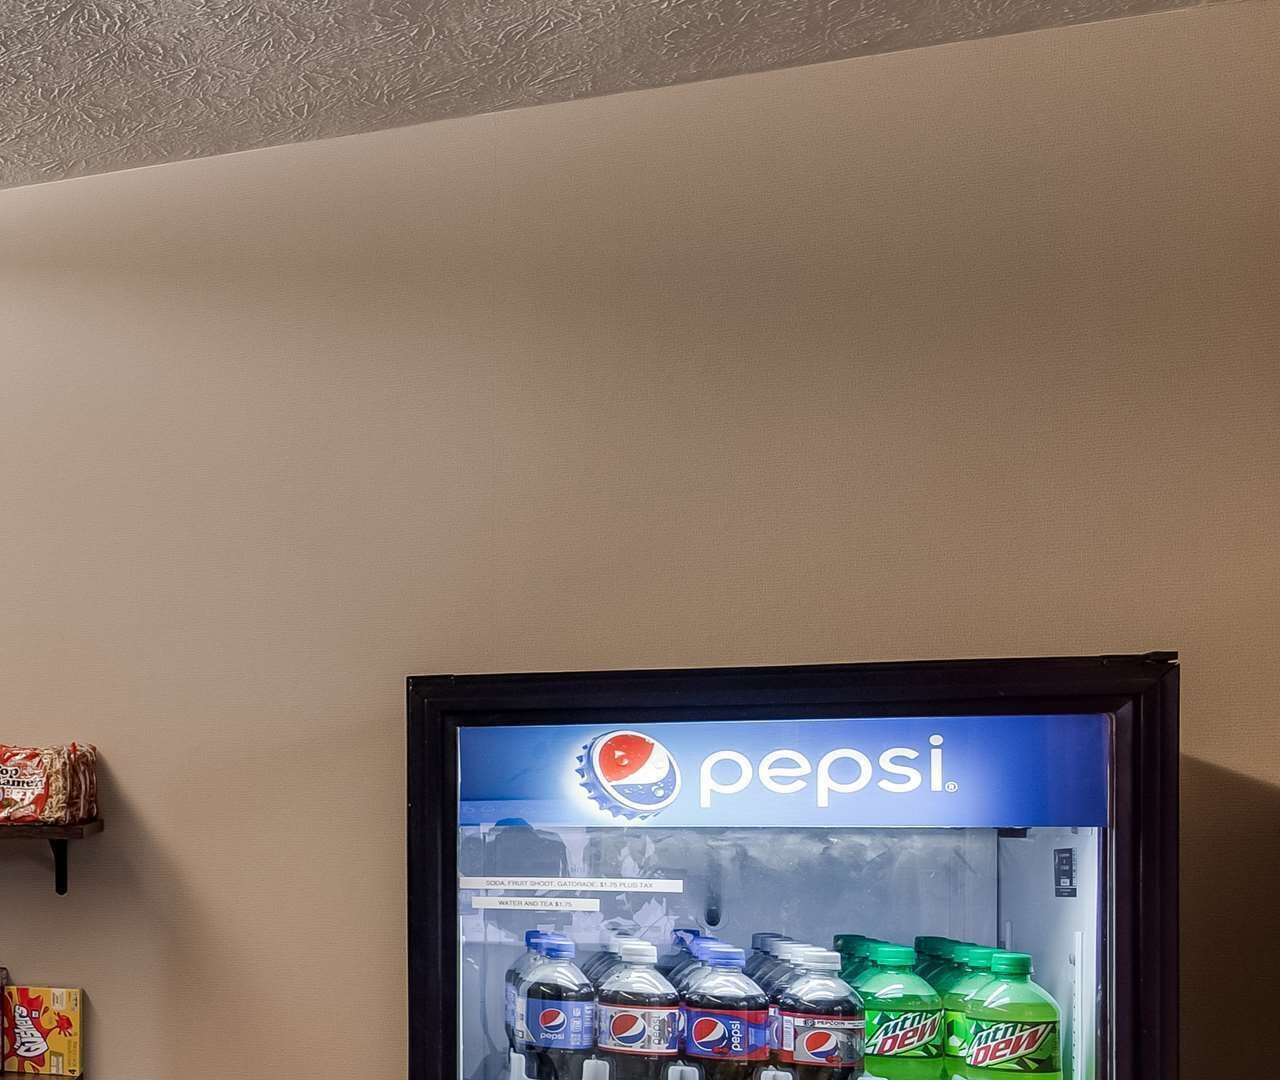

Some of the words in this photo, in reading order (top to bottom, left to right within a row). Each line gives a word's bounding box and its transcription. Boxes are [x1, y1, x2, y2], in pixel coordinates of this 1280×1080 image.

[699, 733, 944, 808] pepsi
[540, 1030, 565, 1041] pepsi
[730, 1019, 741, 1051] pepsi
